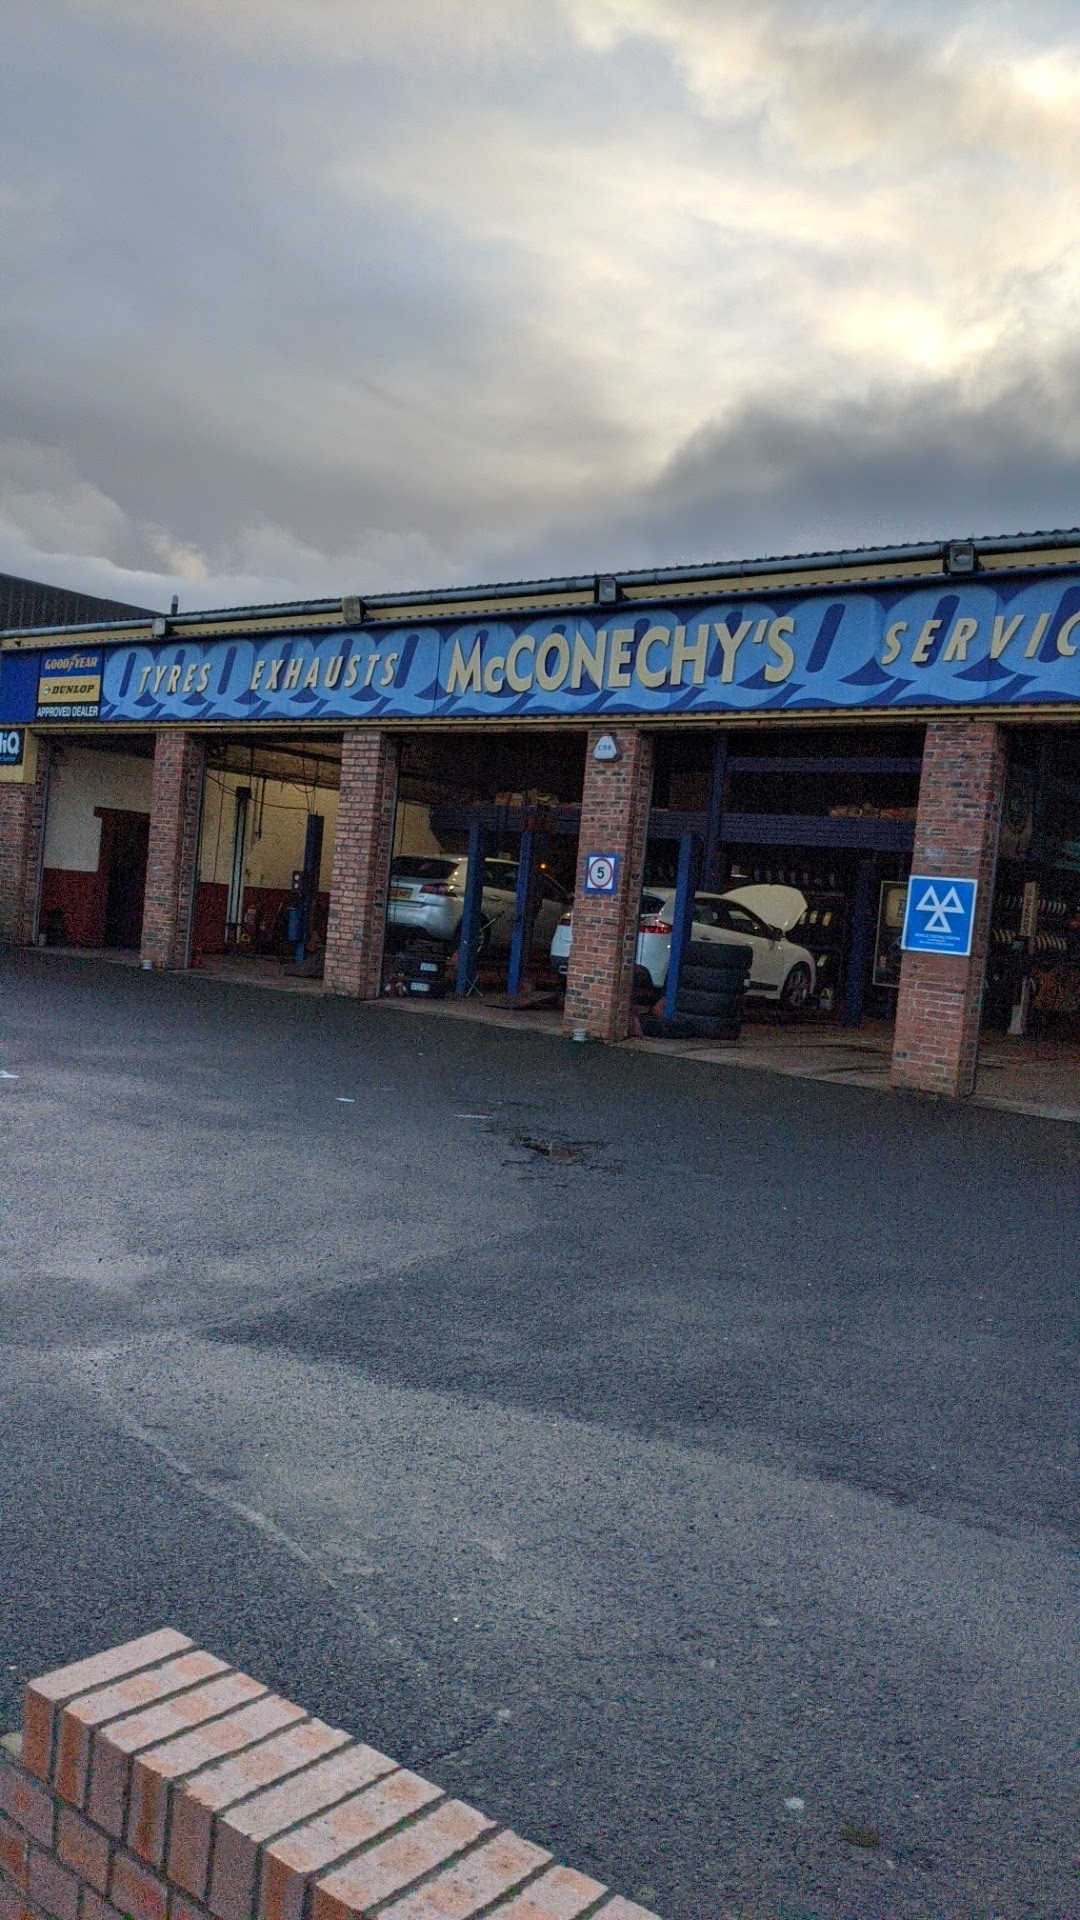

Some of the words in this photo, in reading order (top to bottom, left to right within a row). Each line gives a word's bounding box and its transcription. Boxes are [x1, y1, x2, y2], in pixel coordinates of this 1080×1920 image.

[881, 610, 1080, 665] SERVIC
[45, 654, 98, 671] GOODYEAR
[446, 616, 795, 695] McCONECHY'S
[138, 662, 212, 694] TYRES
[249, 652, 399, 691] EXHAUSTS
[51, 684, 95, 695] DUNLOP
[37, 706, 71, 718] APPROVED
[71, 705, 98, 717] DEALER
[596, 866, 605, 880] 5
